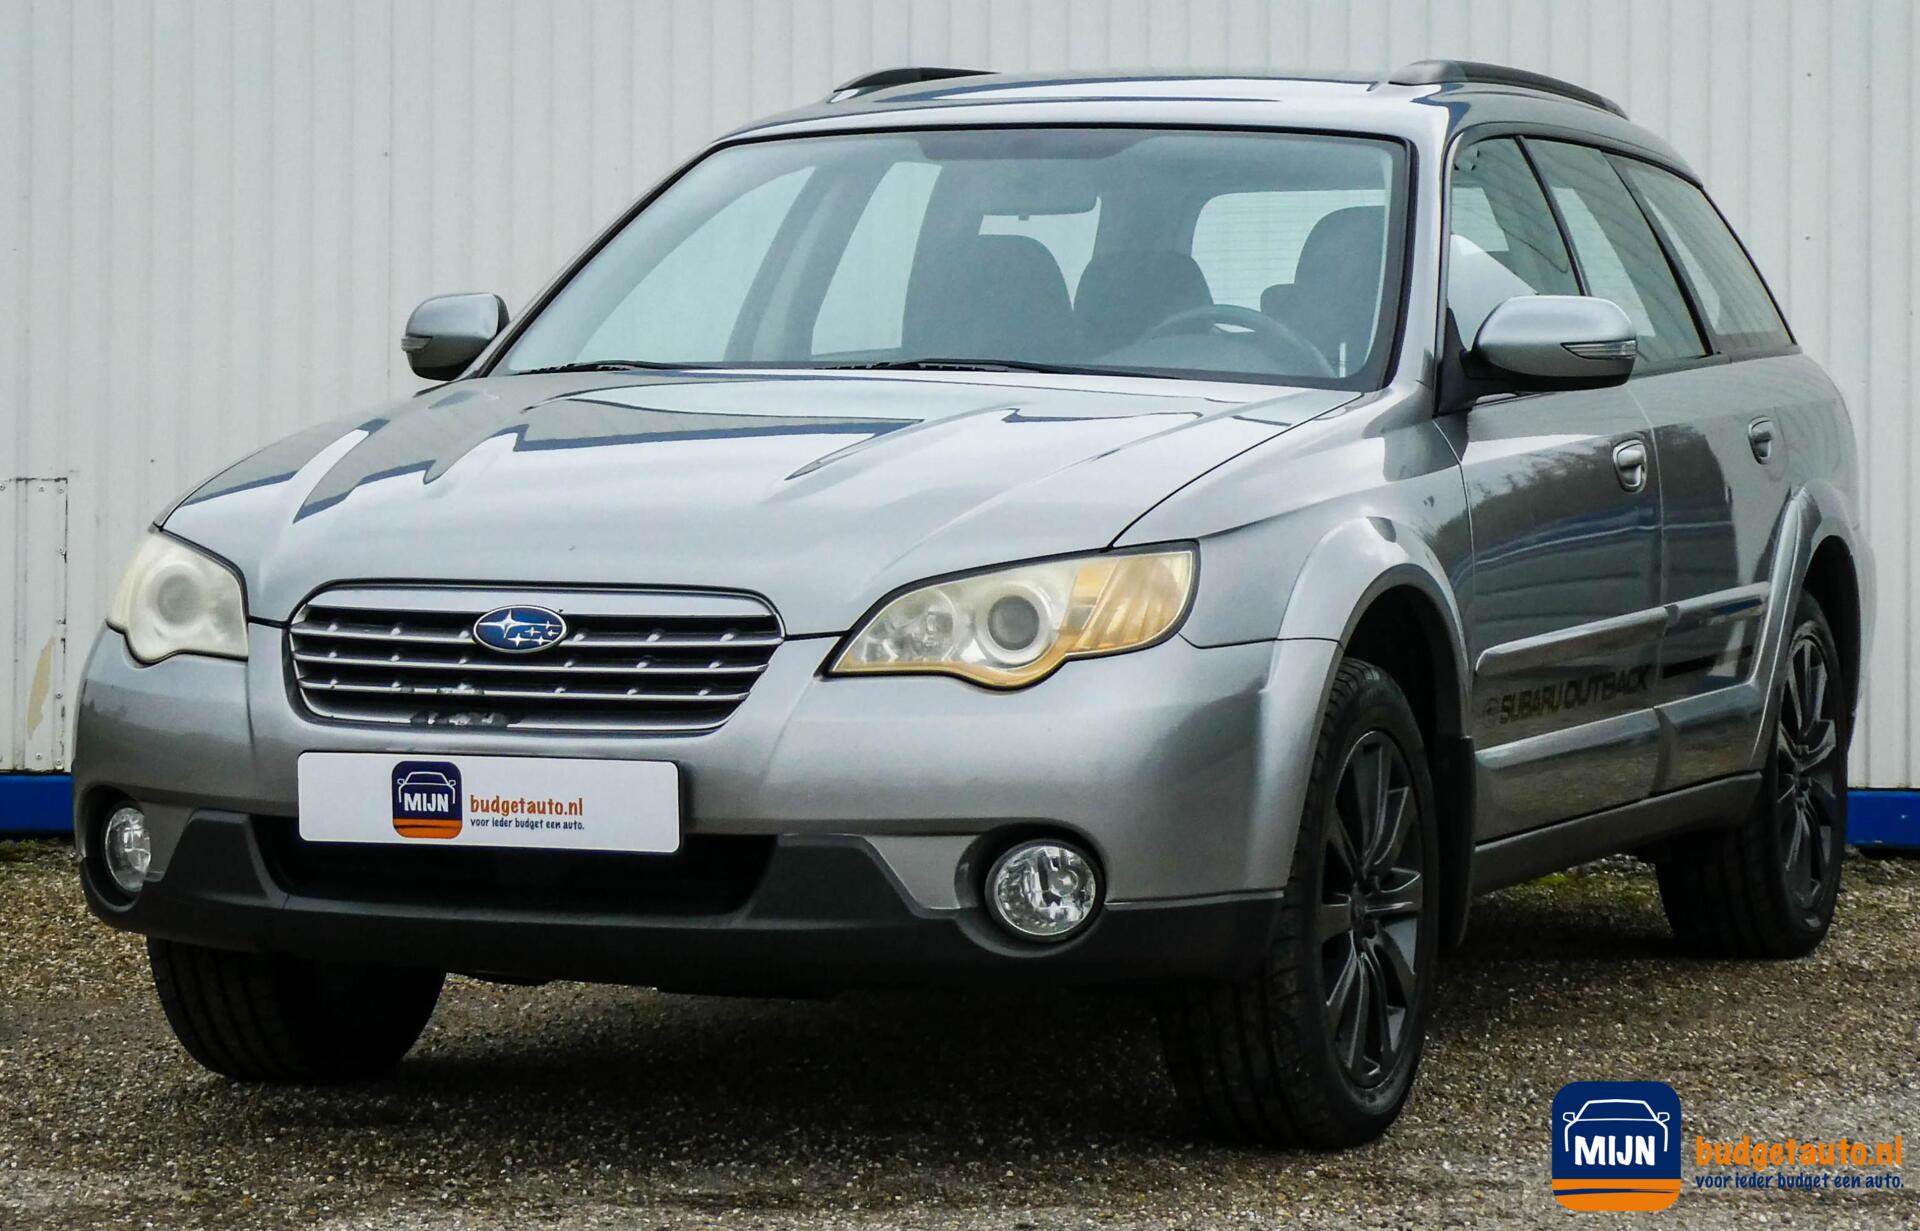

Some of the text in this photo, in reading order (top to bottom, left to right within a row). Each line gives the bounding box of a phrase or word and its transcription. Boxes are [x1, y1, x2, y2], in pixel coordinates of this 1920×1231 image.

[1500, 664, 1650, 724] SUBARU OUTBACK
[404, 792, 449, 813] MIJN
[470, 795, 583, 816] budgetauto.nl
[470, 817, 584, 830] voor ieder budget een auto.
